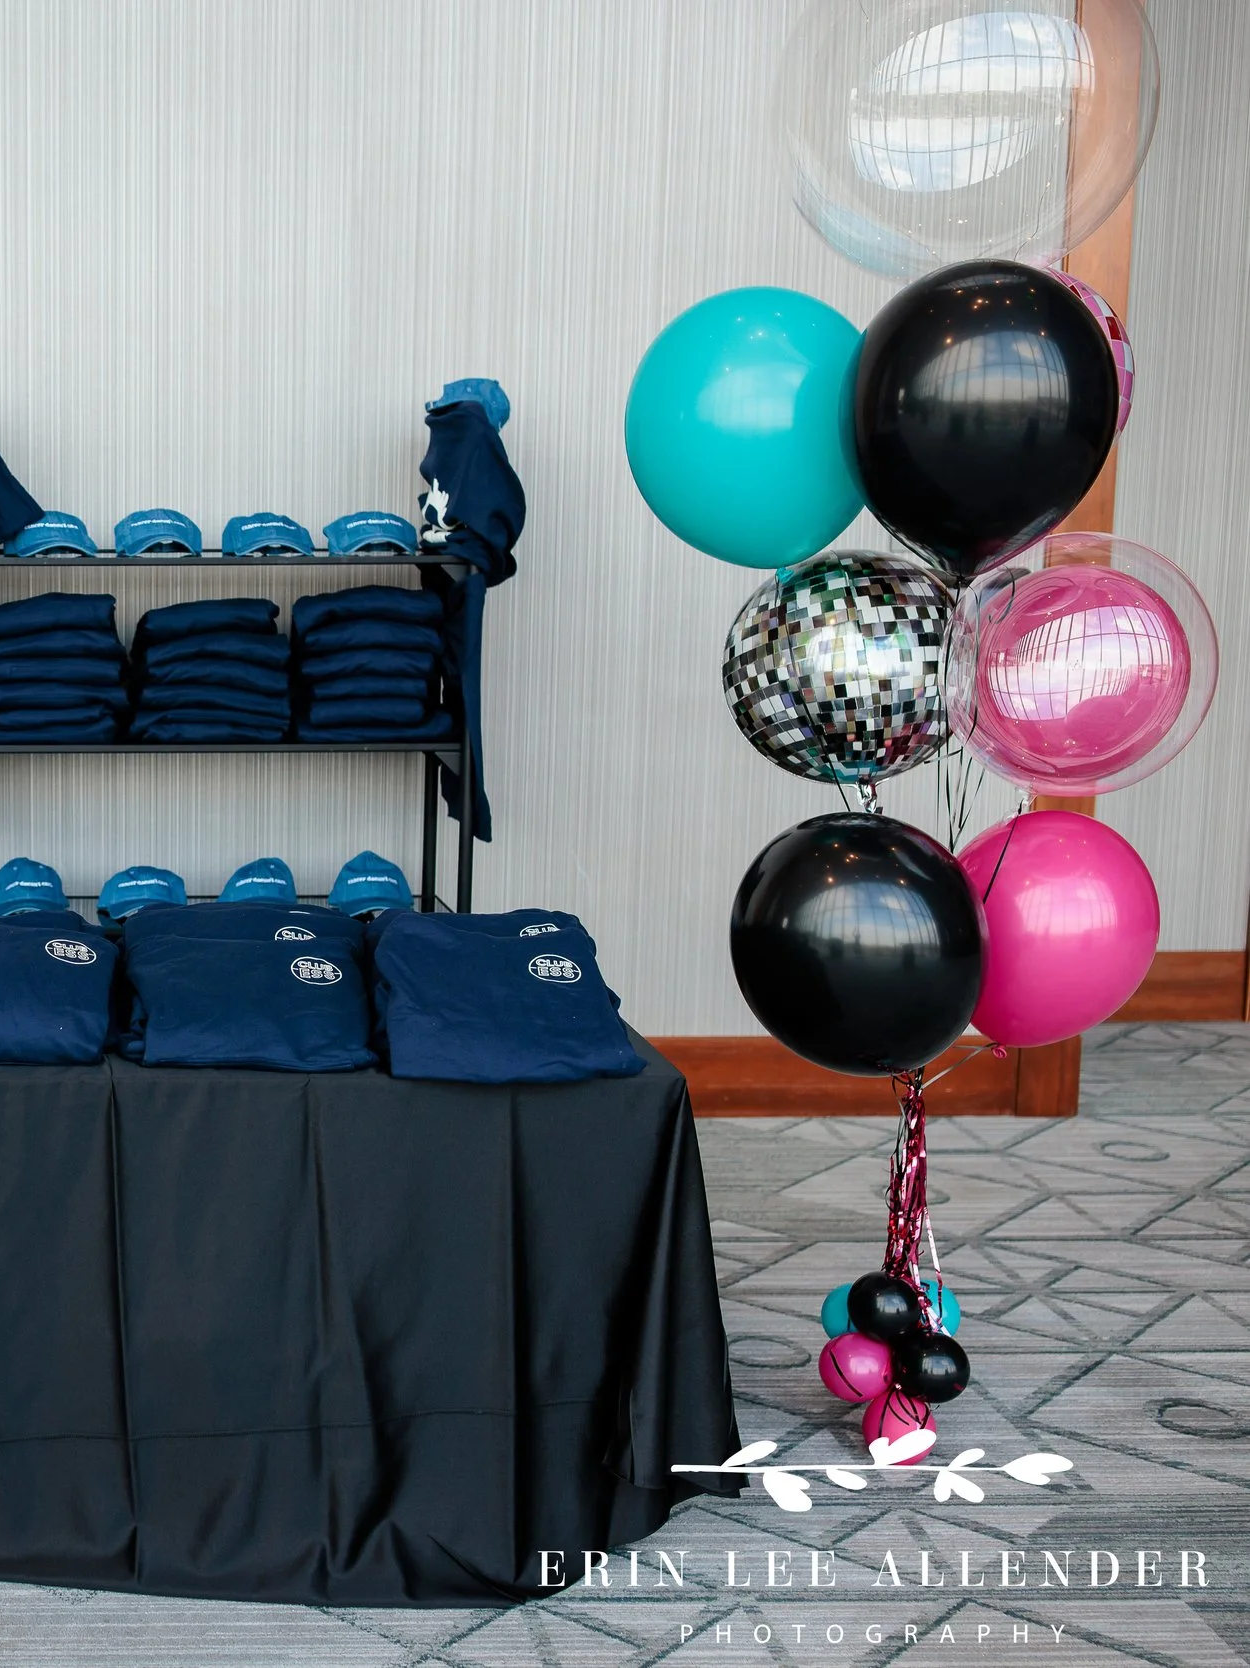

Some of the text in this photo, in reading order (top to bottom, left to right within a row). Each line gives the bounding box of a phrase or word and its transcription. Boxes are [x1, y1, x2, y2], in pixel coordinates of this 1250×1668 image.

[52, 941, 89, 953] CLUB
[297, 960, 334, 972] CLUB
[536, 958, 574, 968] CLUB
